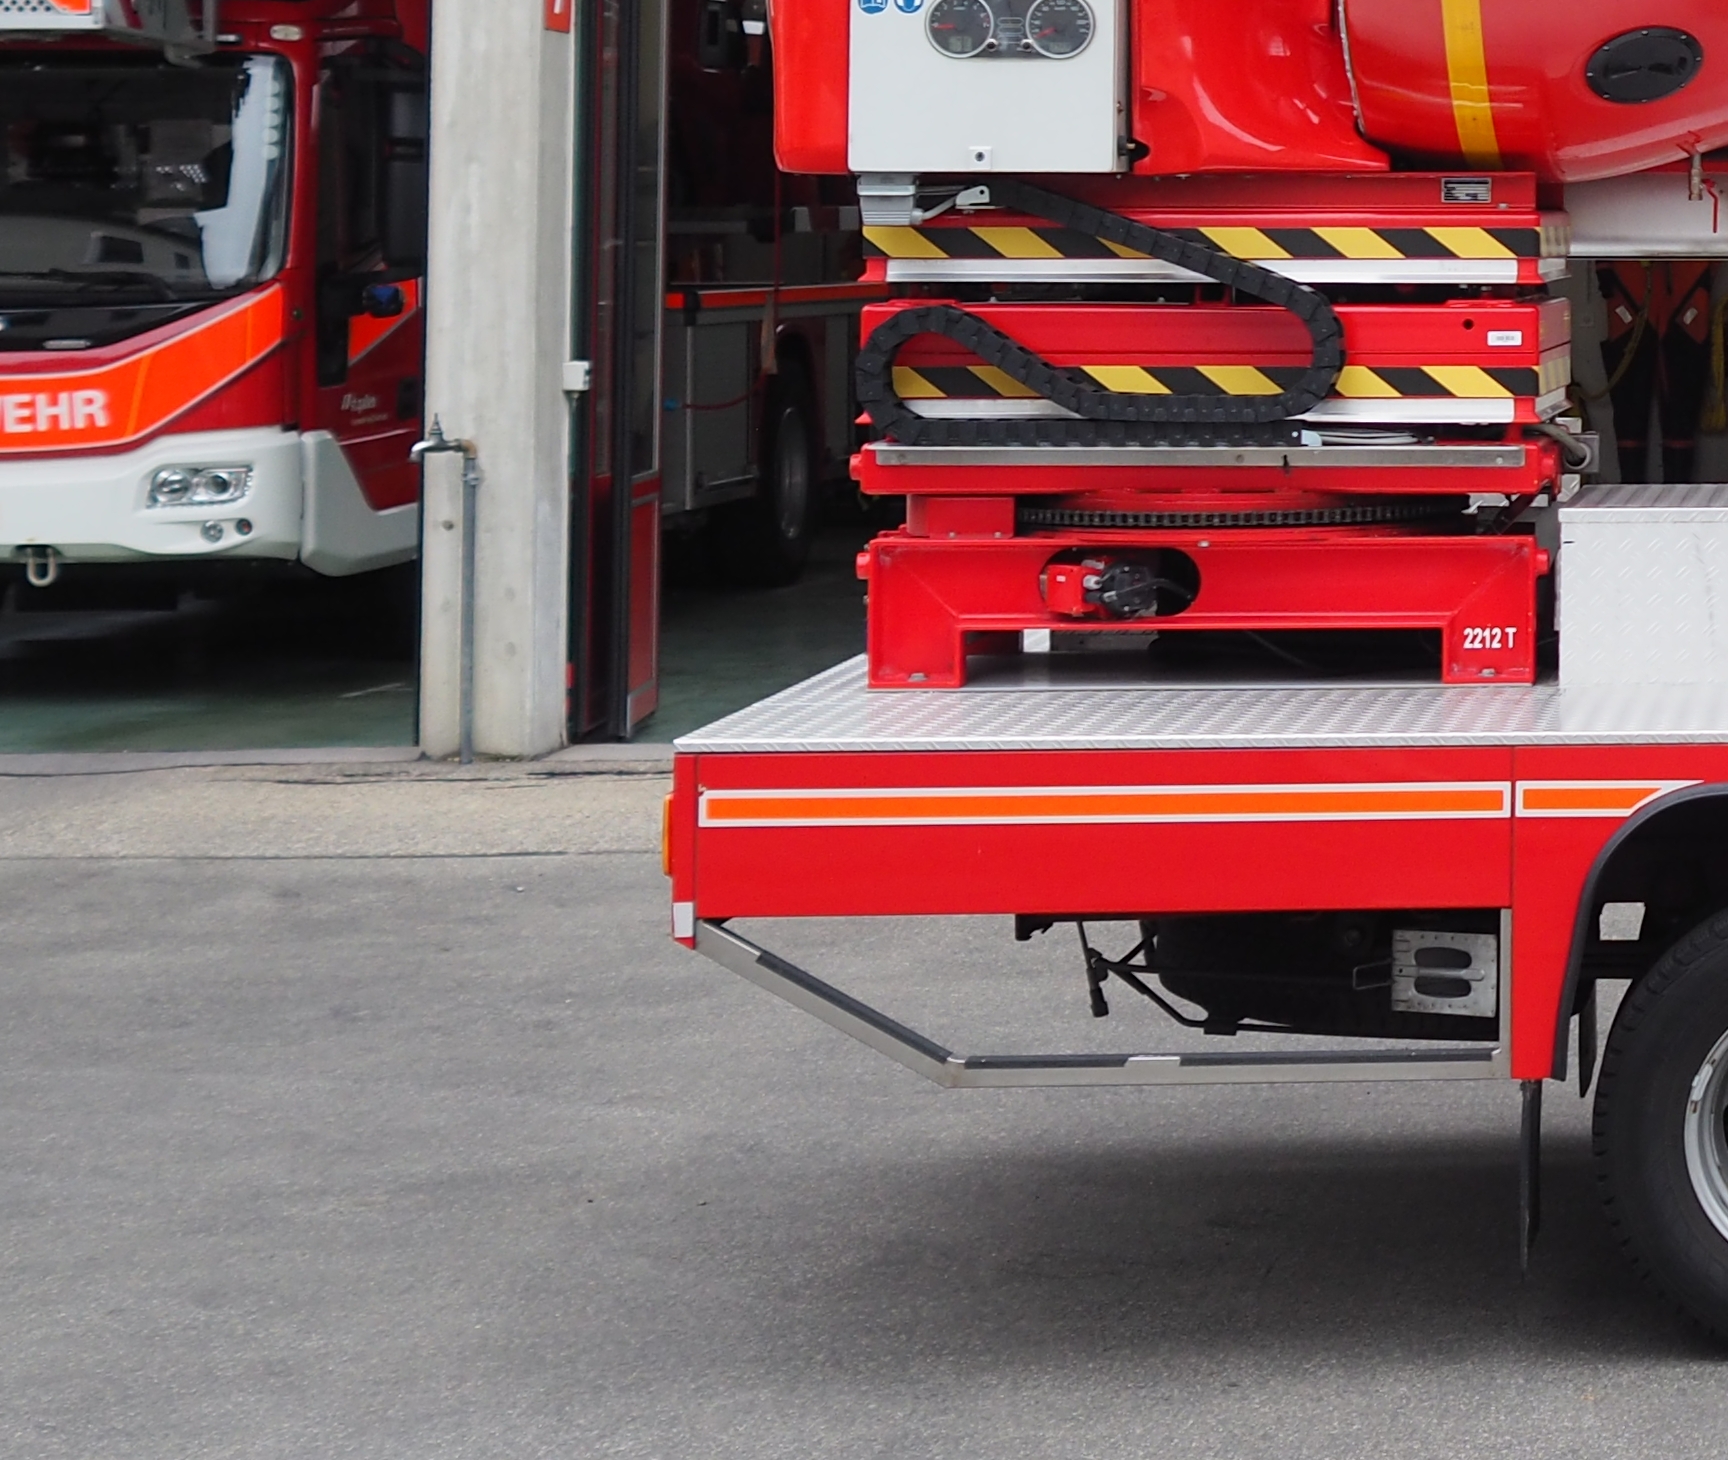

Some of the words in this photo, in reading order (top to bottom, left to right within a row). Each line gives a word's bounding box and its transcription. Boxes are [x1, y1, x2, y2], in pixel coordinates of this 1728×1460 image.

[0, 389, 109, 433] EHR
[1463, 627, 1502, 649] 2212
[1504, 627, 1517, 649] T
